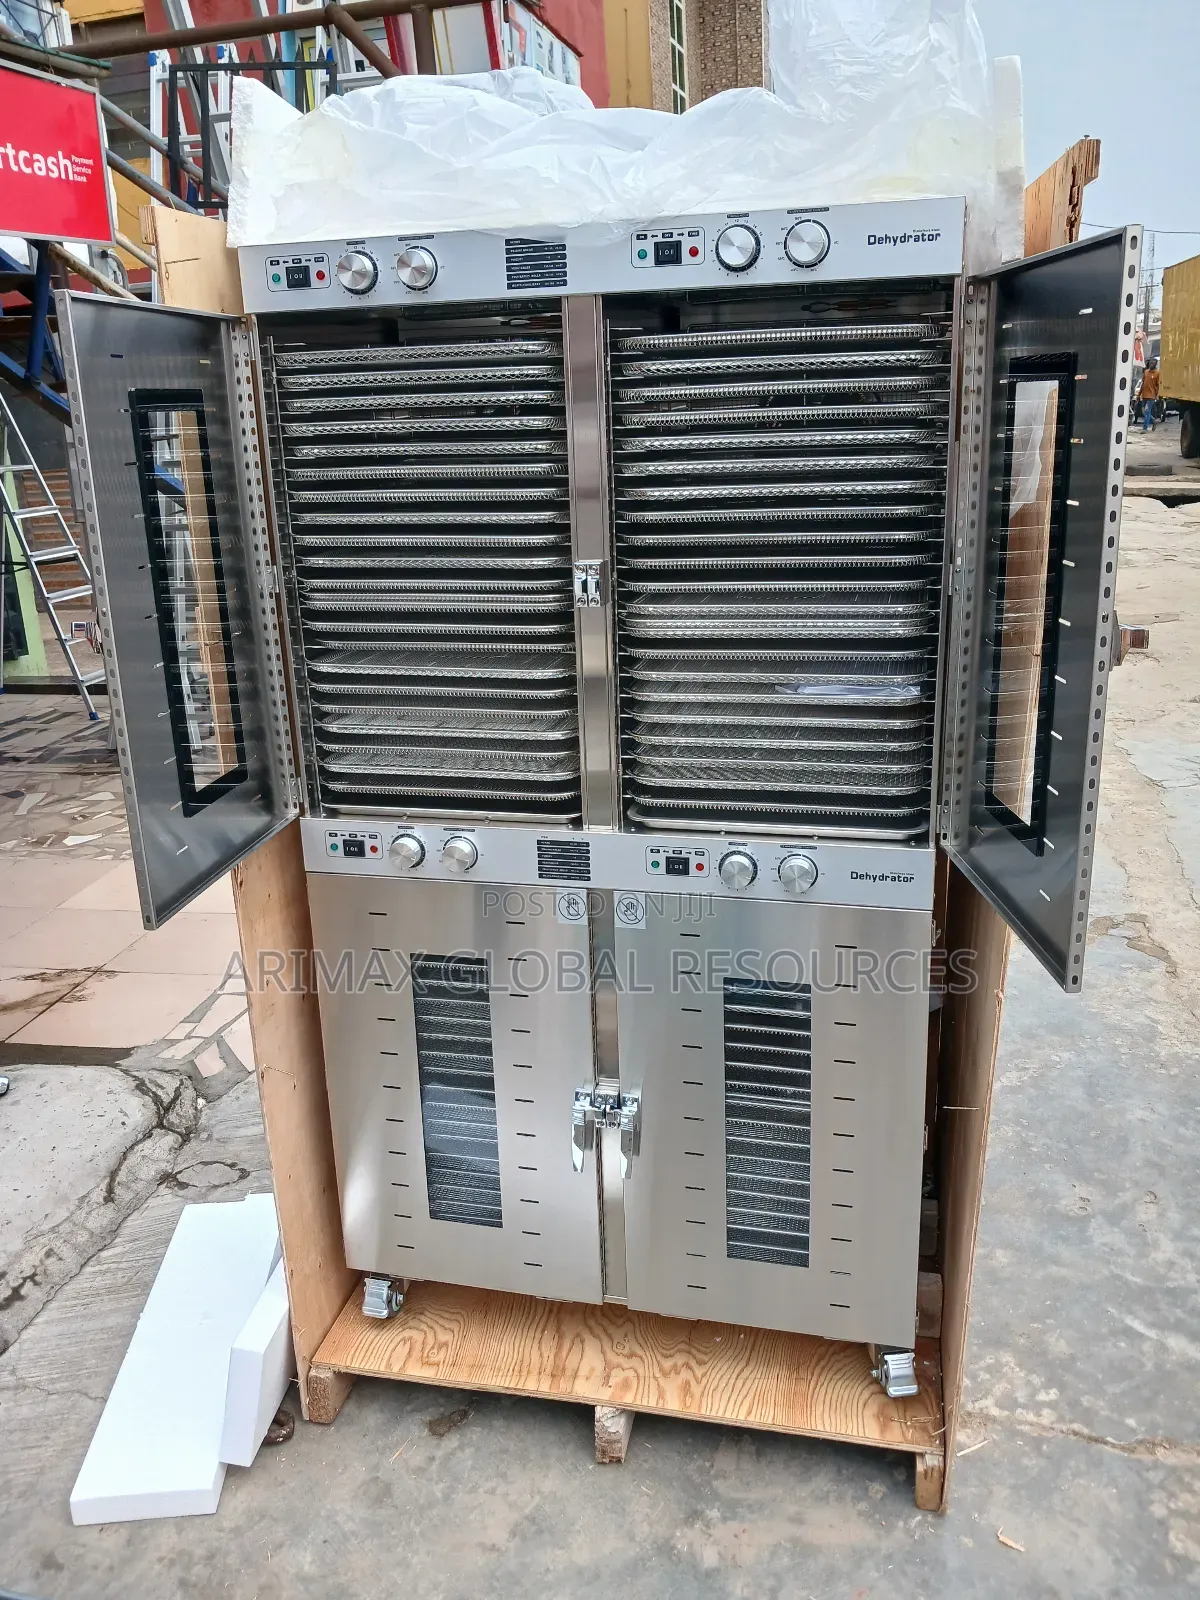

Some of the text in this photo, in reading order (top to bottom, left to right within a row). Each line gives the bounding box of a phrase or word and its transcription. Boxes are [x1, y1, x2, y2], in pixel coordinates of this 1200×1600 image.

[71, 154, 94, 166] Payment
[72, 165, 92, 175] Service
[73, 174, 88, 183] Bank
[867, 232, 941, 247] Dehydrator
[850, 871, 915, 883] Dehydrator
